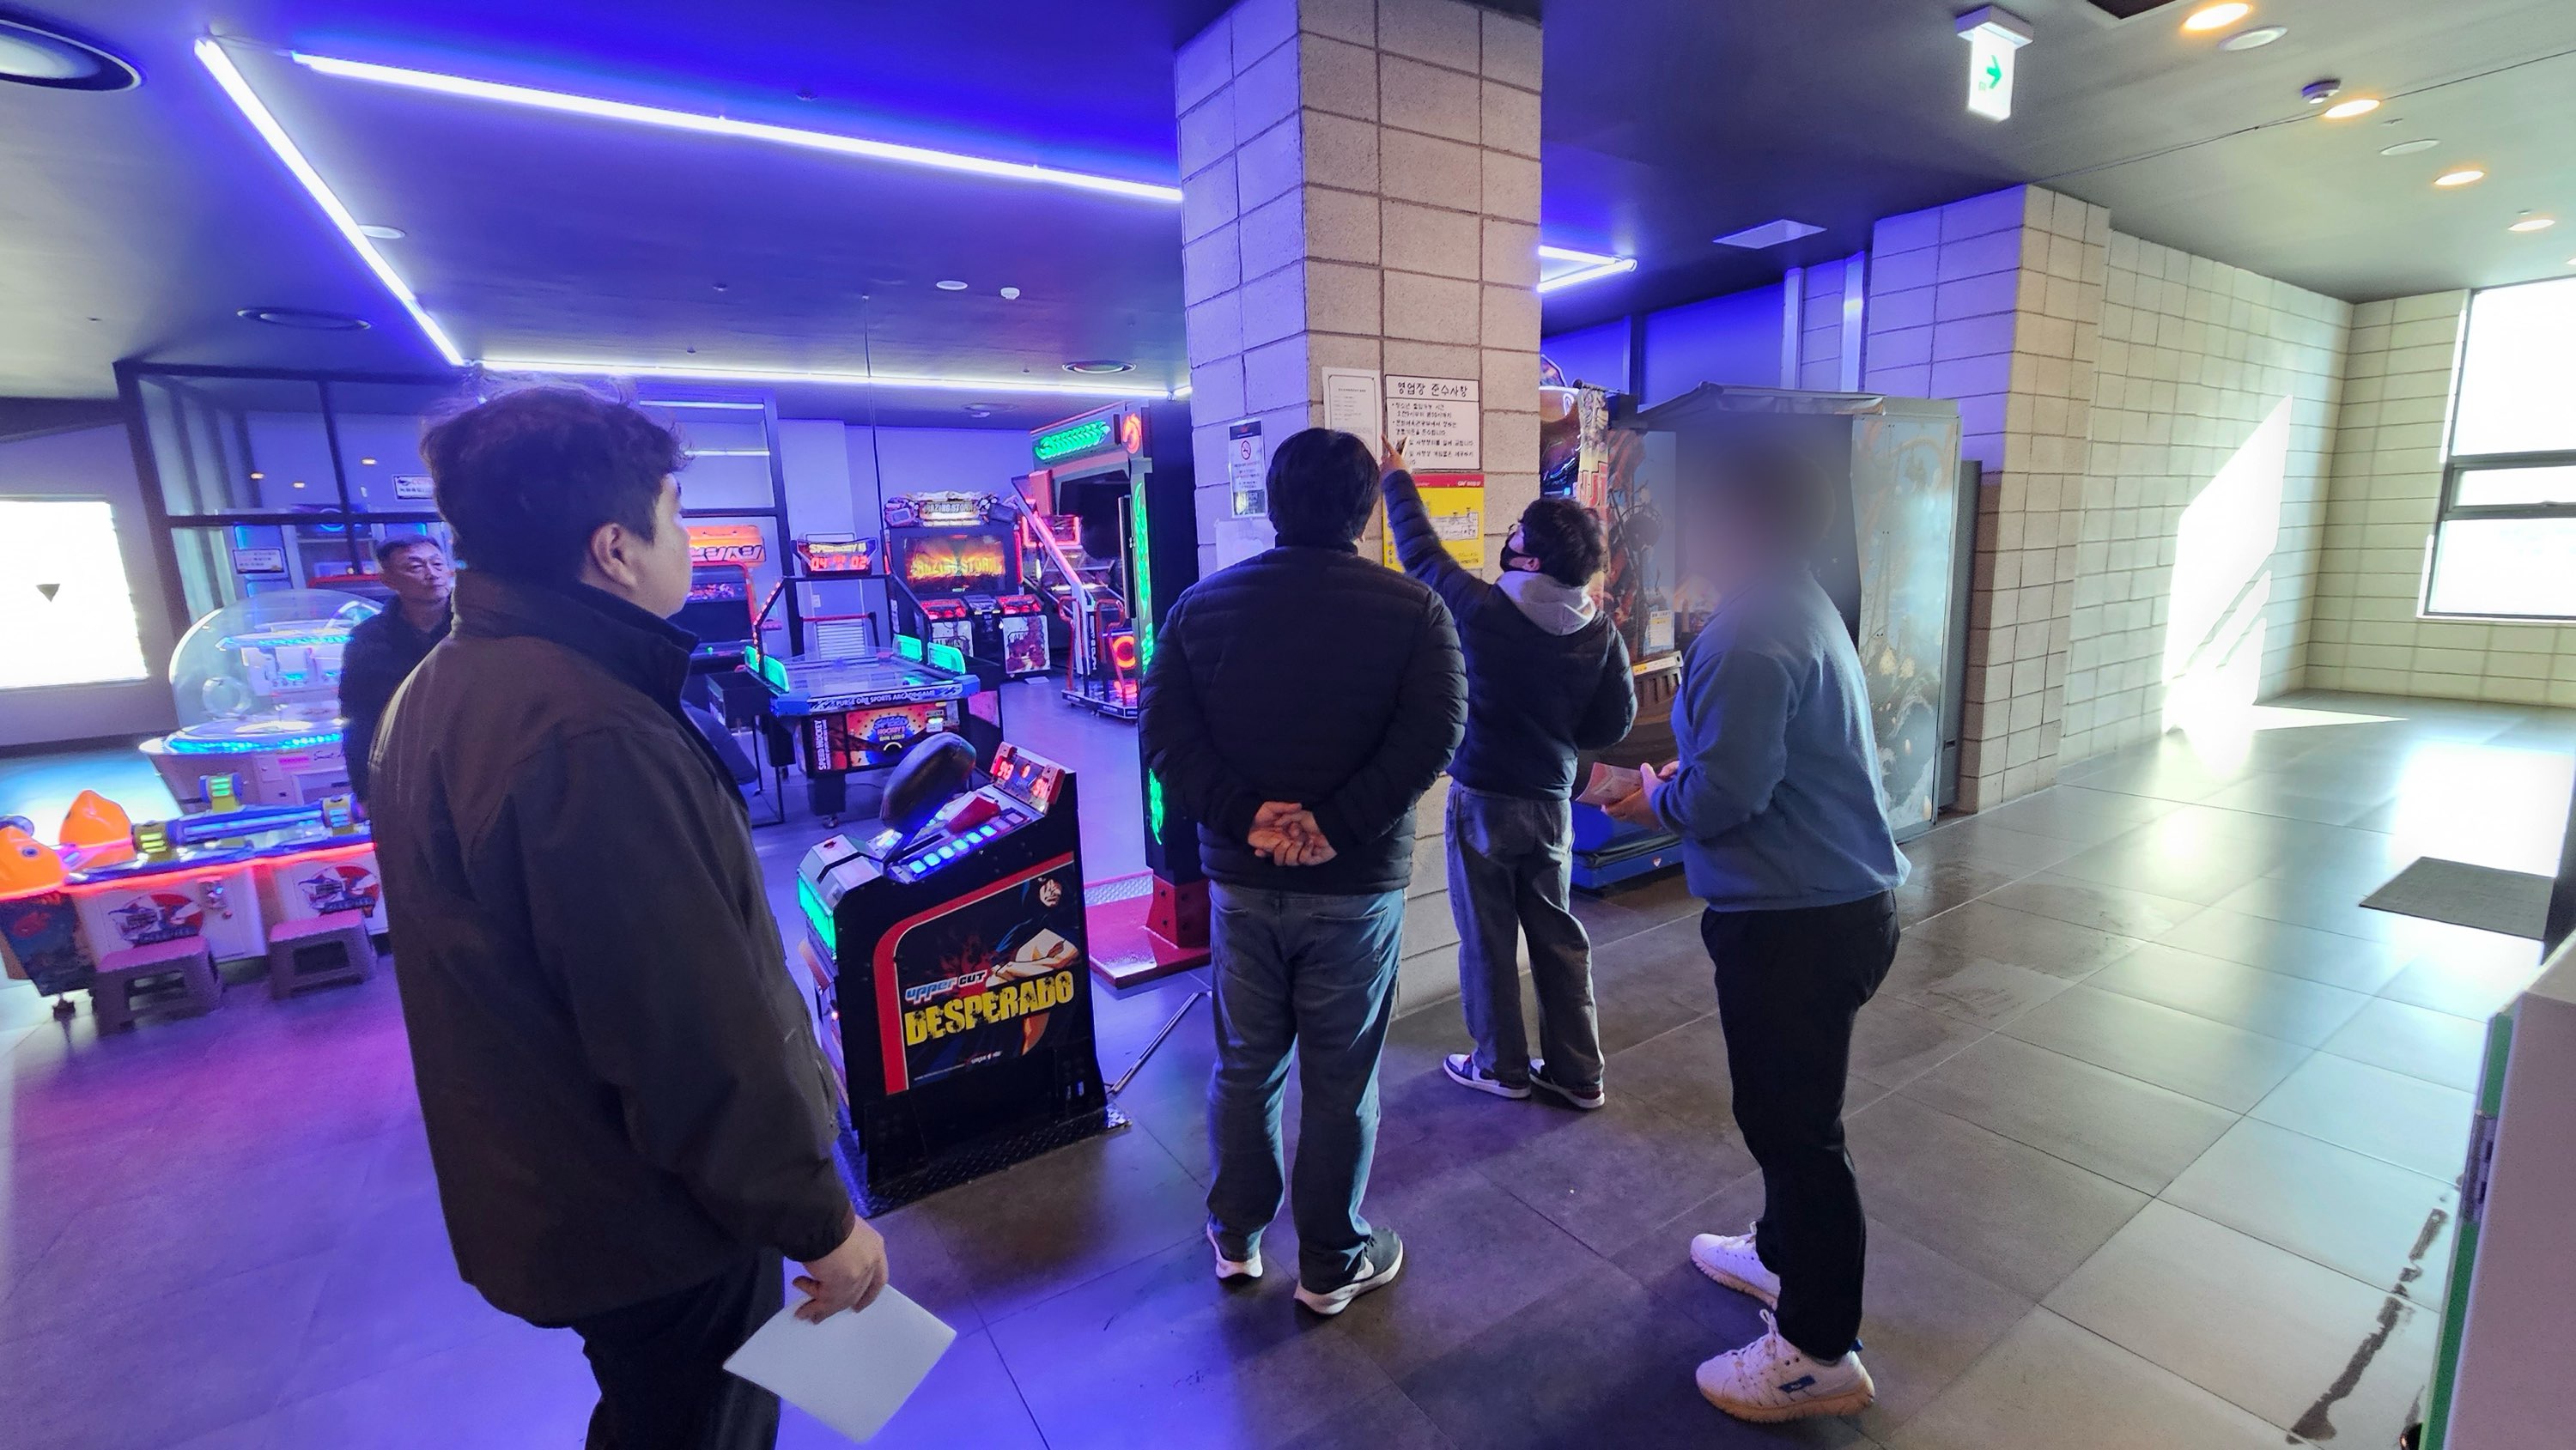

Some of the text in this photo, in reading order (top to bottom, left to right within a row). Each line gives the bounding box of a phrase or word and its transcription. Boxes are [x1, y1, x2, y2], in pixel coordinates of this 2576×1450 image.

[1398, 382, 1467, 397] 영업장 준수사항
[904, 970, 1074, 1047] DESPERADO
